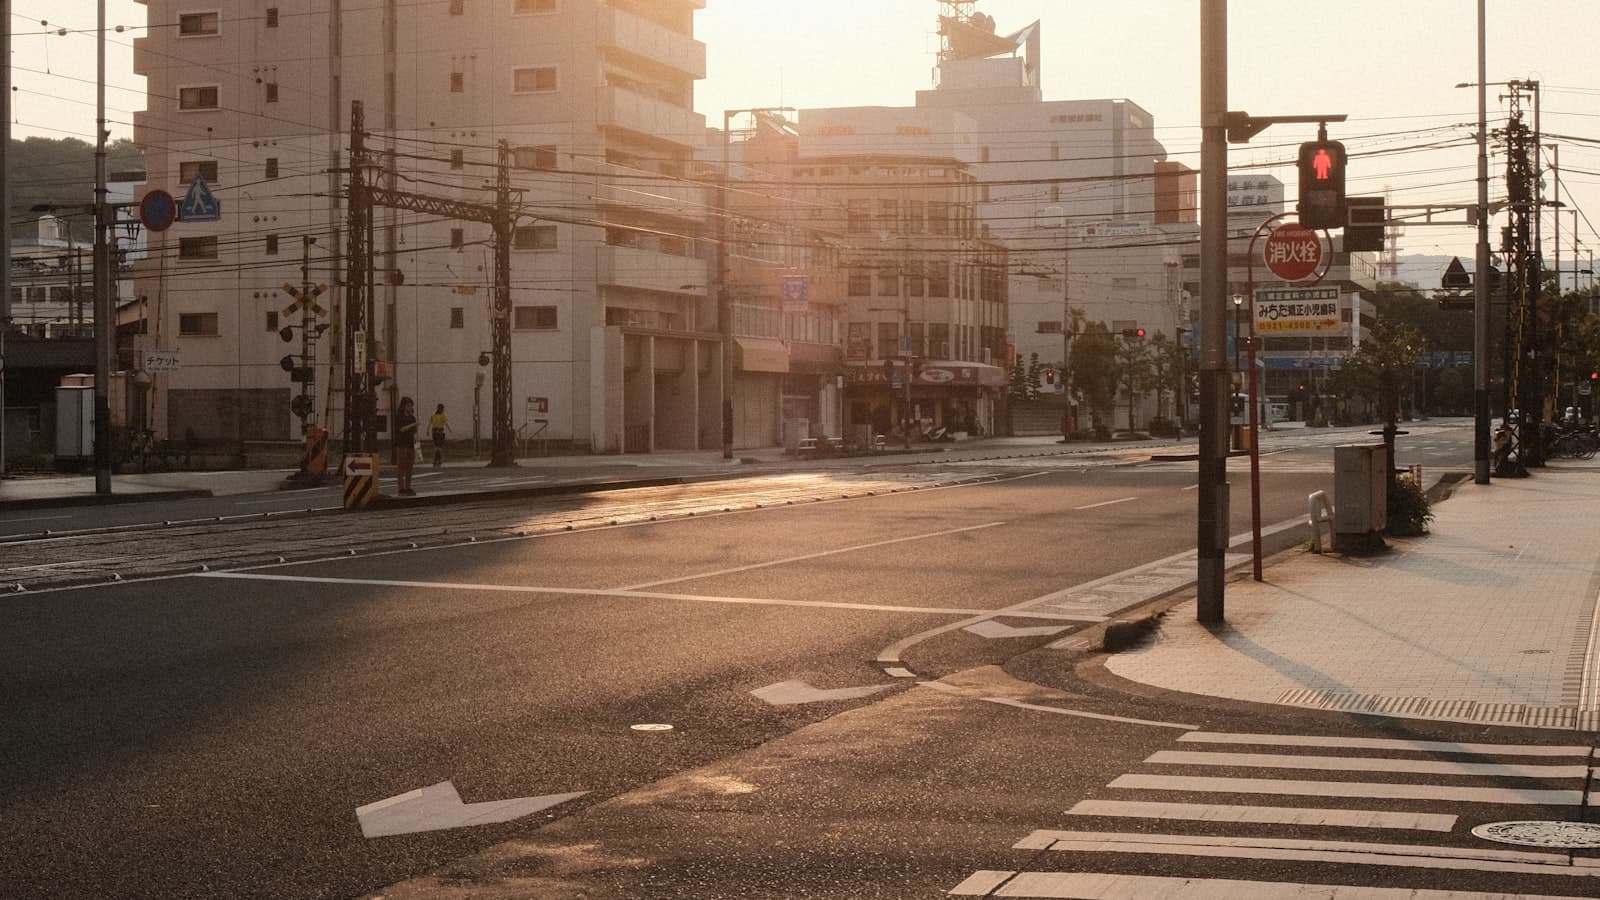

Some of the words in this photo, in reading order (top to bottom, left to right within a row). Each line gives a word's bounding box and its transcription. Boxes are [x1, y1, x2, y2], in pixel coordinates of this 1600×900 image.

[1270, 240, 1317, 263] 消火栓
[1259, 303, 1336, 320] みちた矯正小児歯科
[146, 357, 179, 366] チケット
